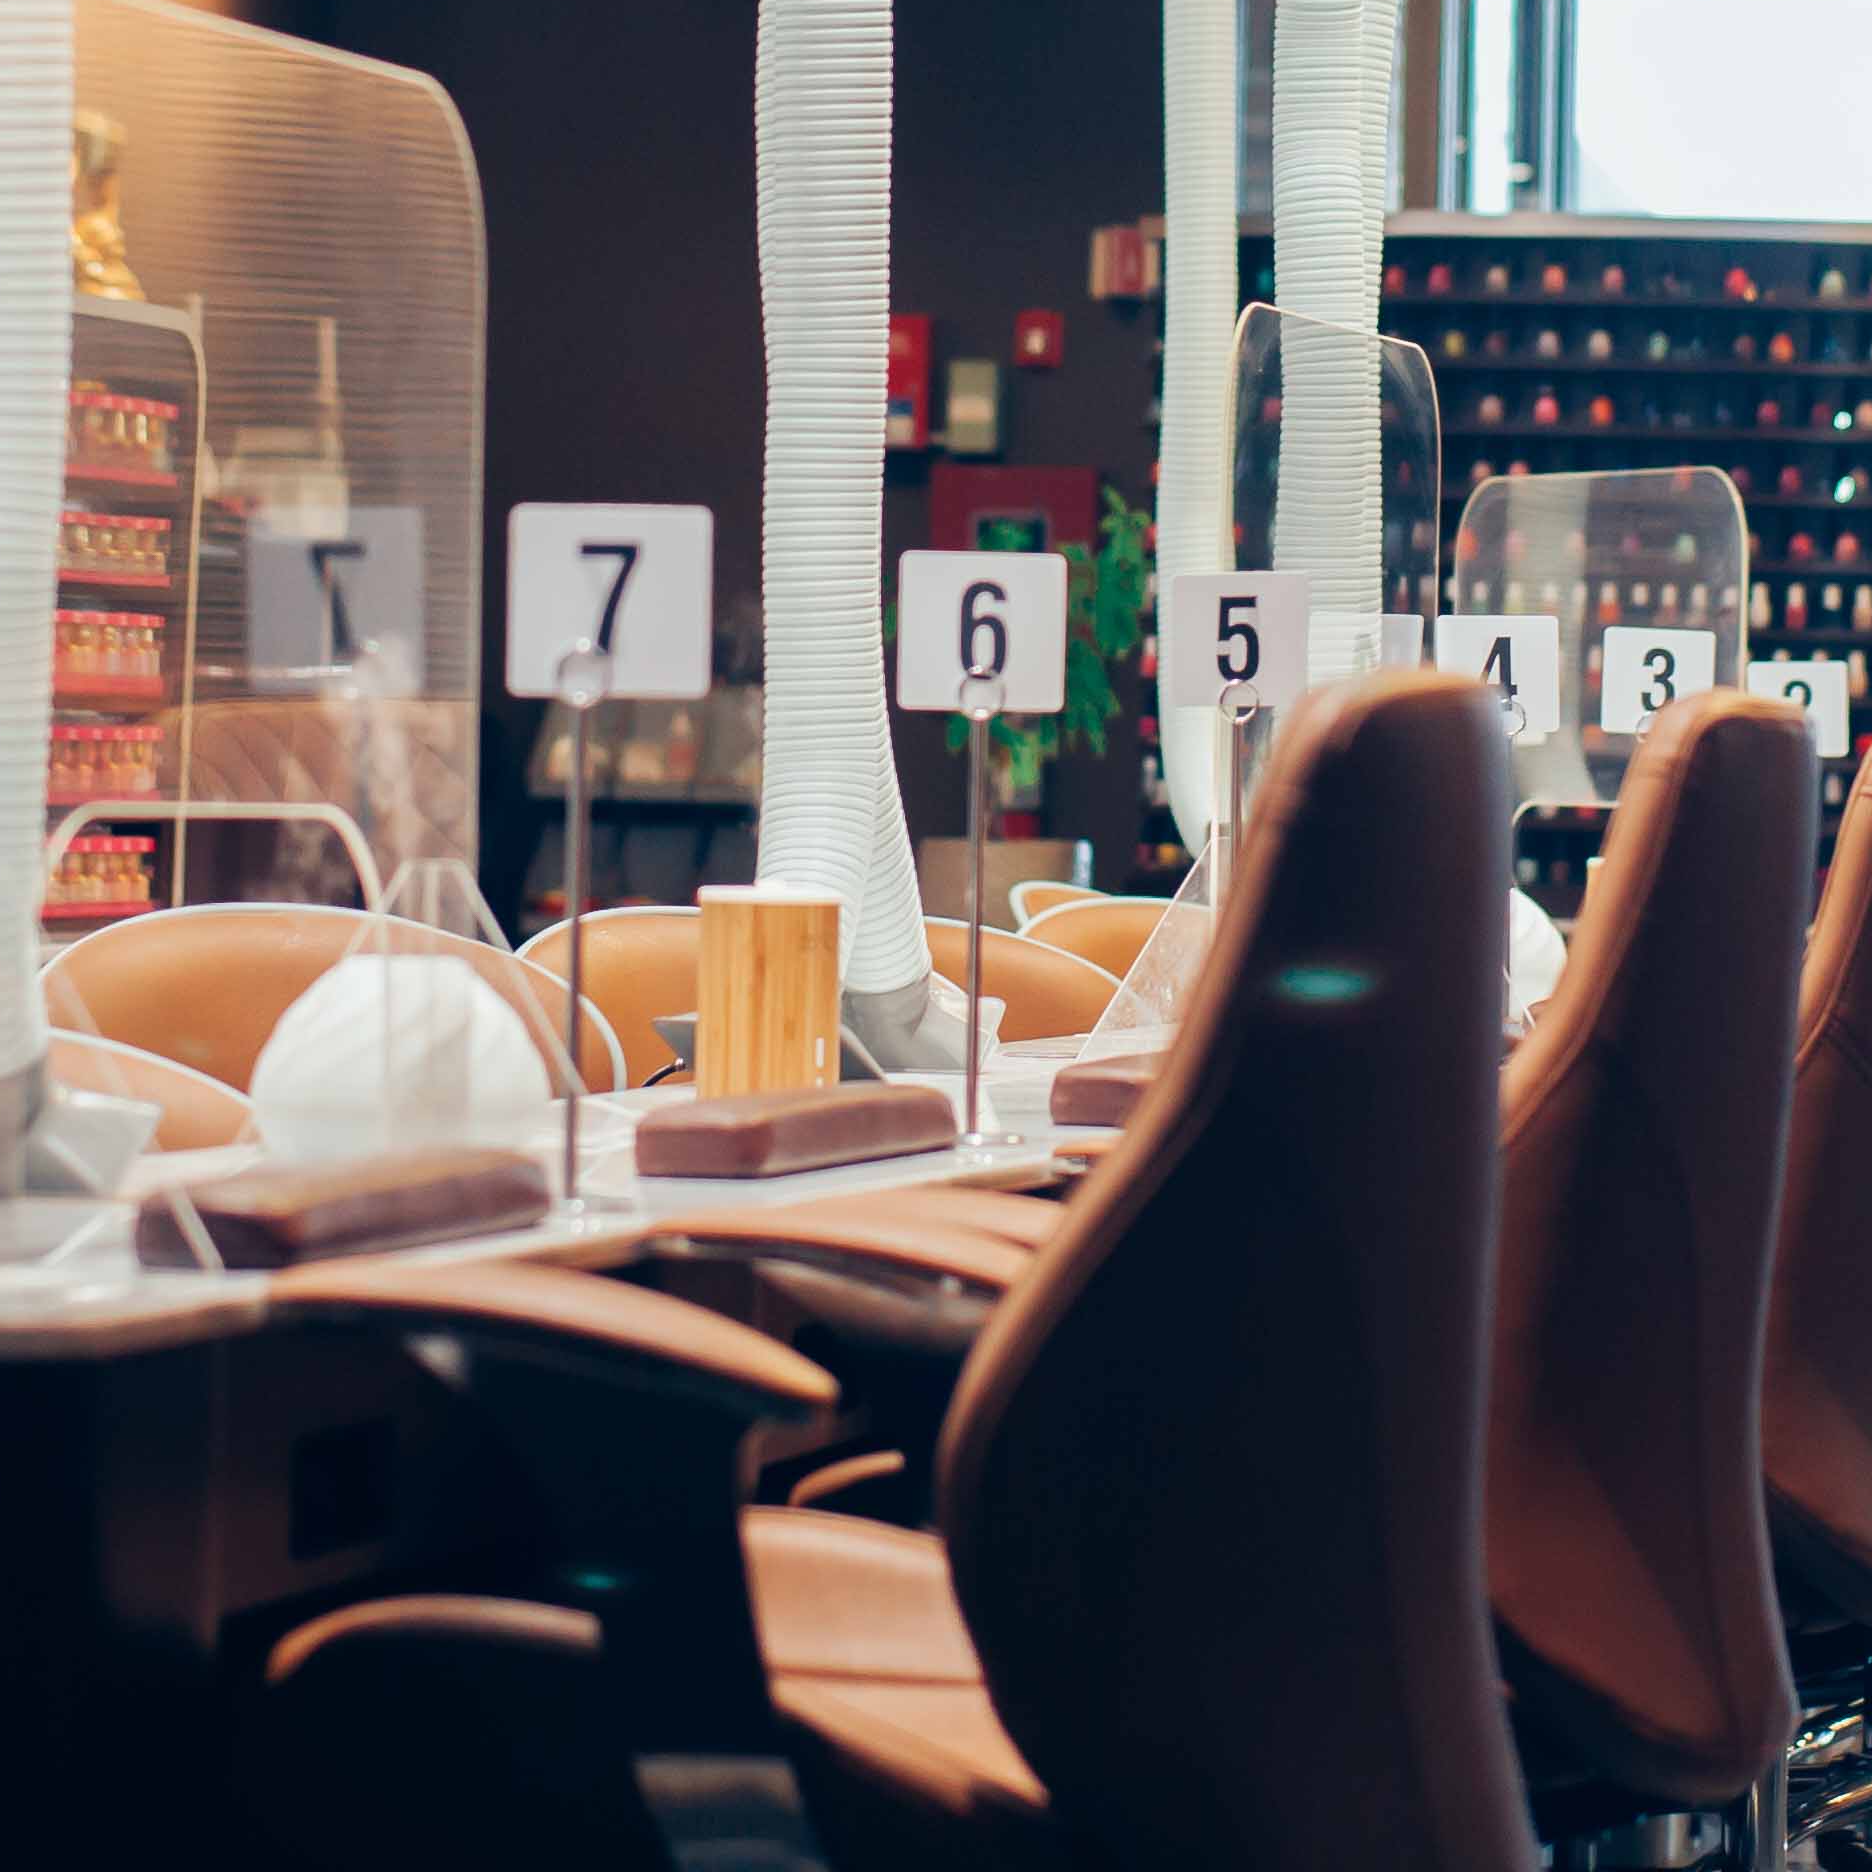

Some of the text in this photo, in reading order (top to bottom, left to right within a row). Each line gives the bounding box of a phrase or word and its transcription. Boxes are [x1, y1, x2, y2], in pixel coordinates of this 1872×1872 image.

[580, 544, 639, 656] 7
[961, 581, 1006, 680] 6
[1217, 596, 1259, 682] 5
[1481, 635, 1518, 711] 4
[1640, 647, 1675, 712] 3
